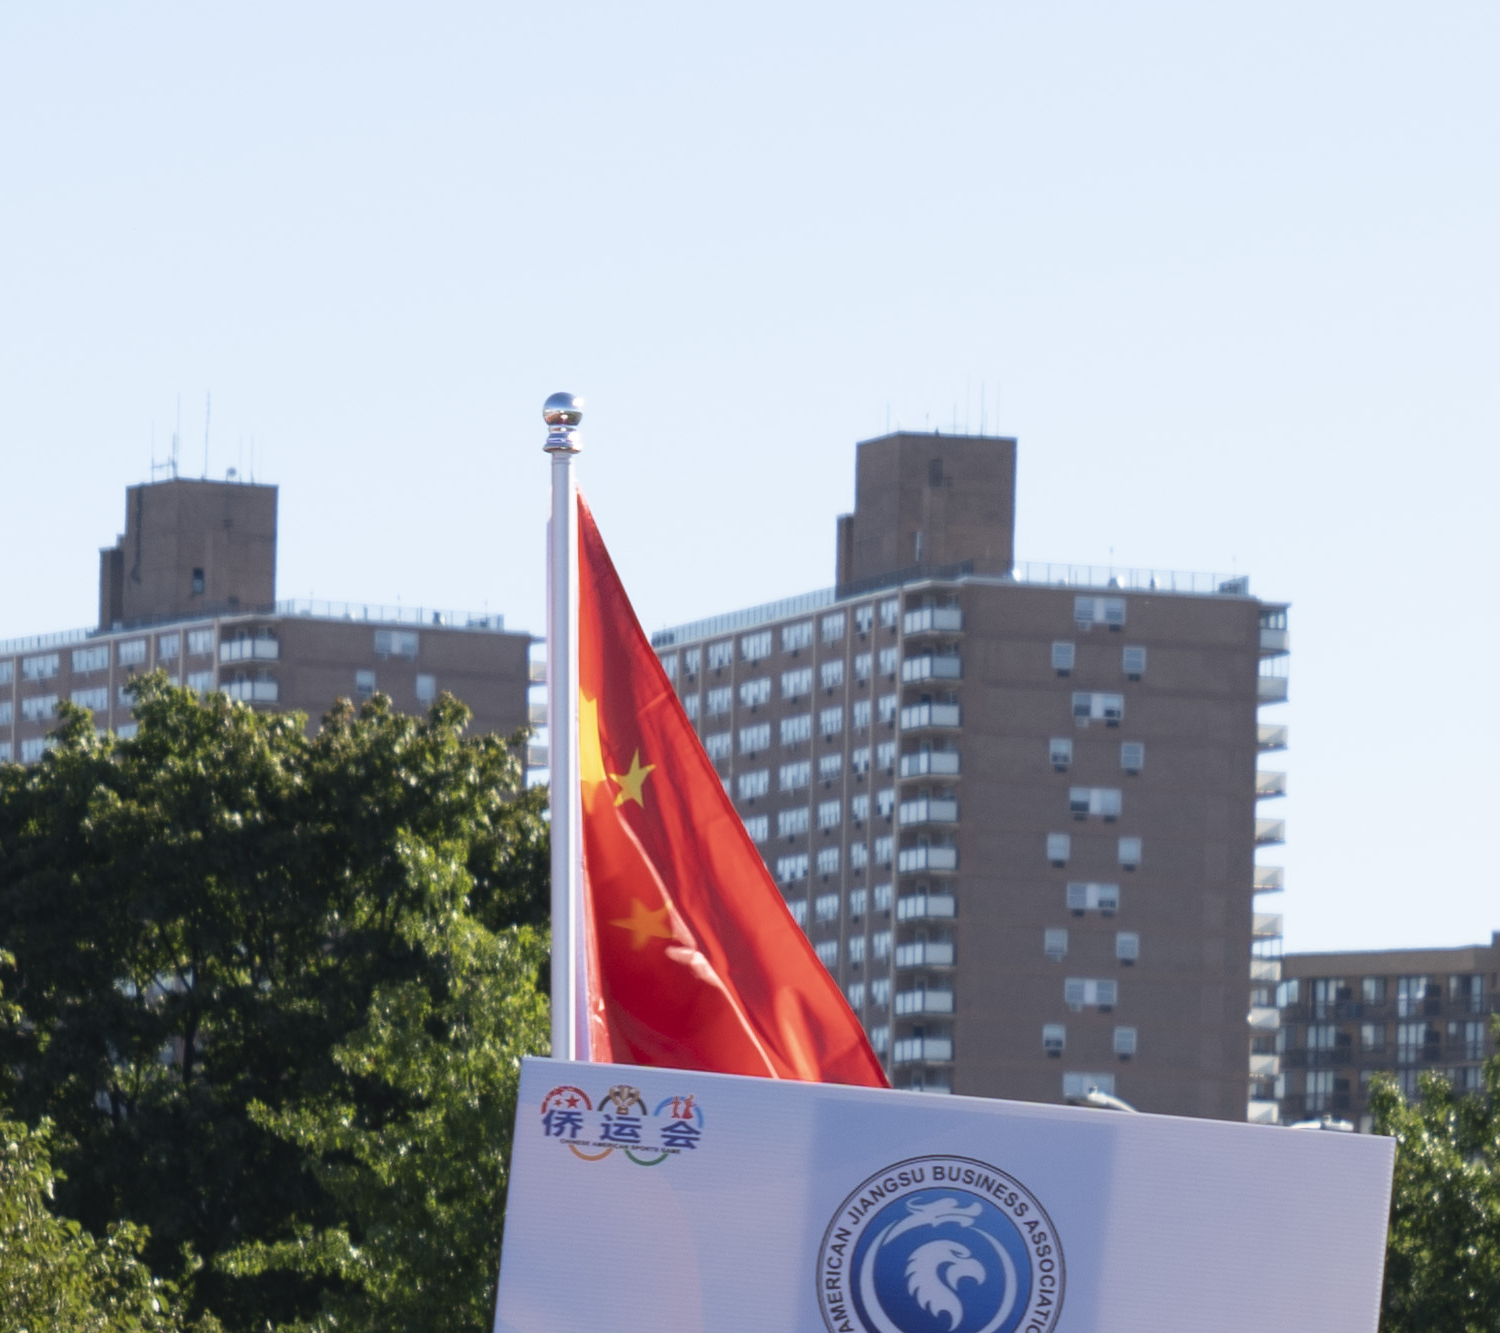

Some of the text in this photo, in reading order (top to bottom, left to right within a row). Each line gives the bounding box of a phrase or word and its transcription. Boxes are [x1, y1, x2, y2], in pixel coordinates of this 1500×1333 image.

[542, 1109, 702, 1150] 侨运会
[847, 1167, 926, 1226] JIANGSU
[932, 1165, 1029, 1218] BUSINESS
